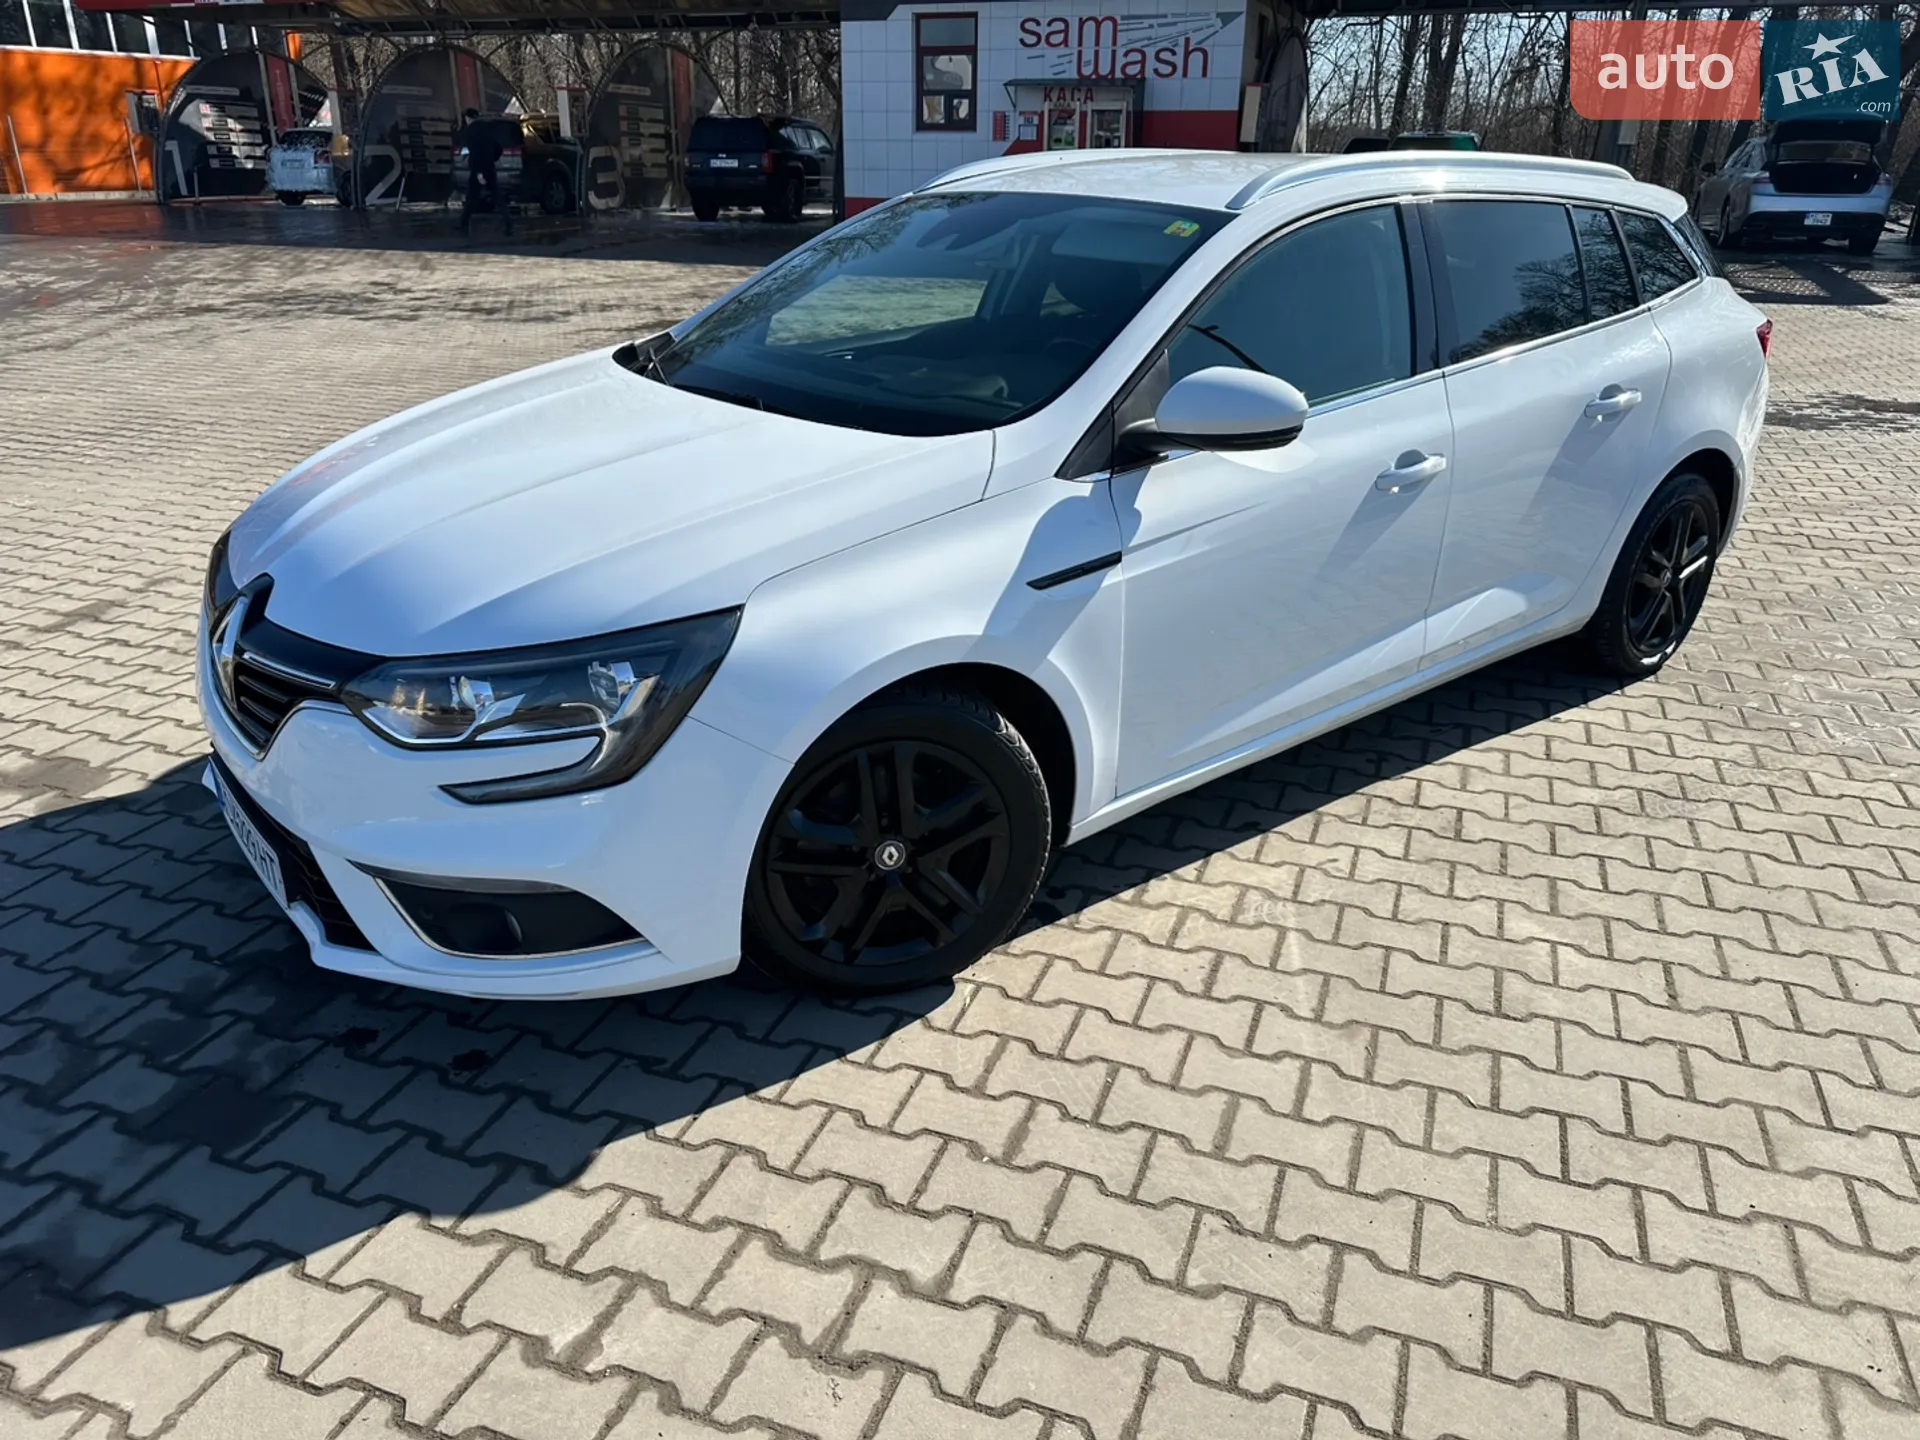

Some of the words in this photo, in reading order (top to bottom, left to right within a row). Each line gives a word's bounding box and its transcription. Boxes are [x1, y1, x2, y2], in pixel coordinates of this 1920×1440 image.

[1019, 16, 1118, 47] sam
[1077, 37, 1209, 78] wash
[164, 140, 188, 198] 1
[364, 144, 407, 205] 2
[588, 146, 625, 210] 3
